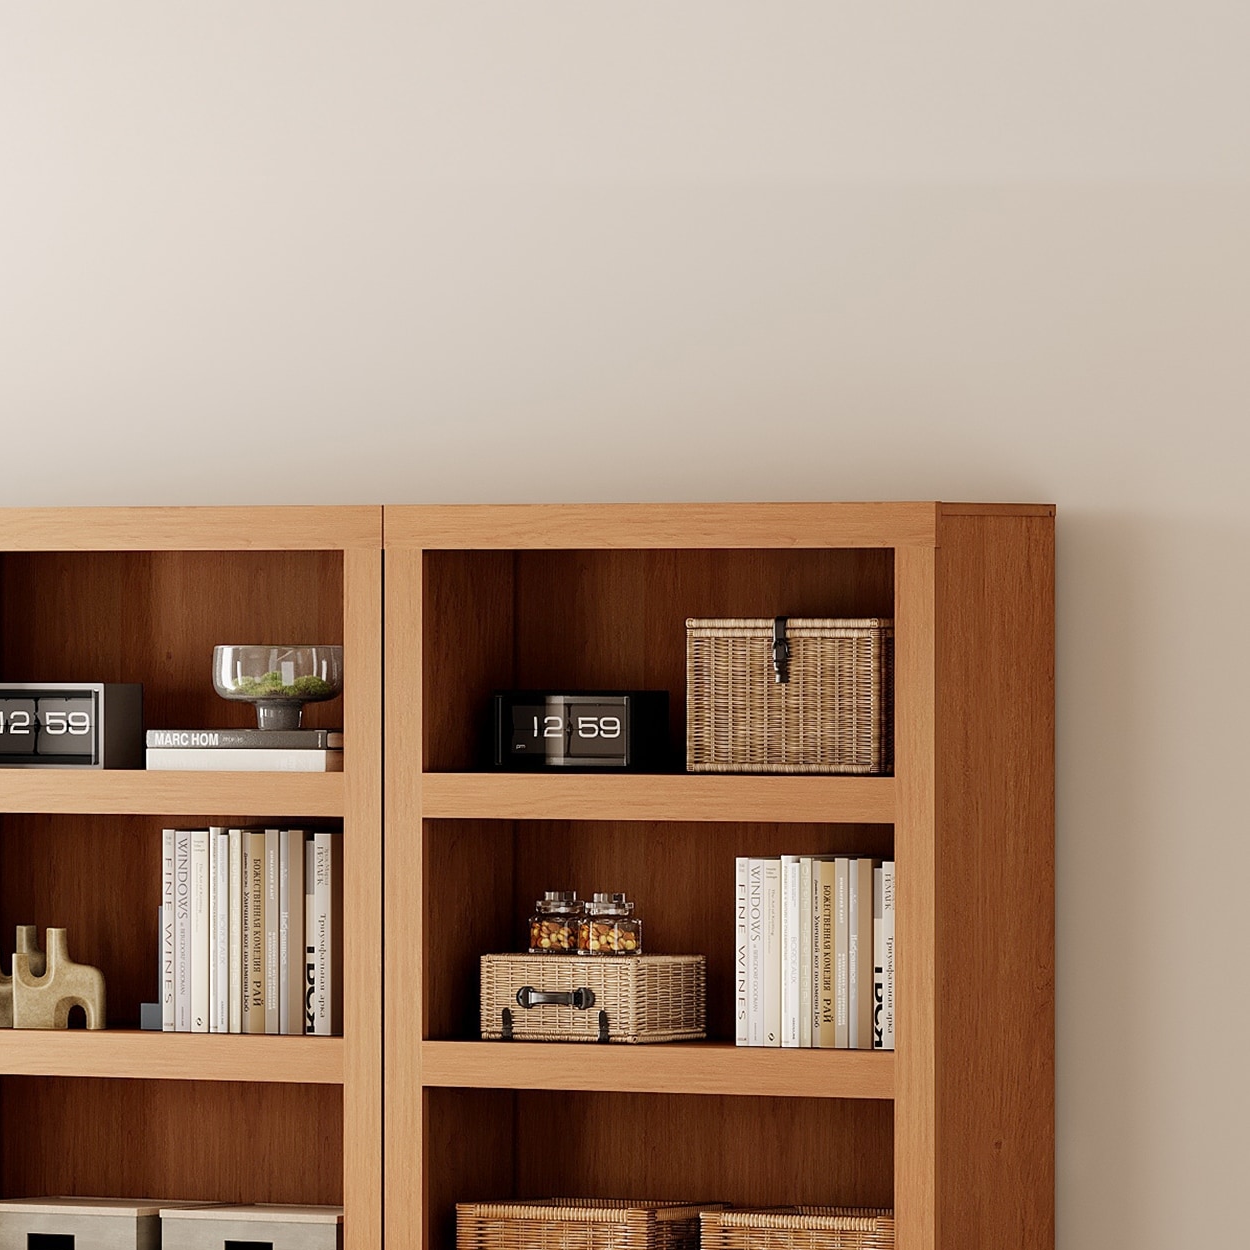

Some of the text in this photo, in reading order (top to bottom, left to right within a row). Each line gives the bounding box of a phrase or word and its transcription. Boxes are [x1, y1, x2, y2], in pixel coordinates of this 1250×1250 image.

[45, 711, 90, 735] 59
[154, 733, 189, 746] MARC
[191, 733, 219, 746] HOM
[578, 716, 620, 739] 59
[177, 838, 188, 919] WINDOWS
[751, 865, 761, 942] WINDOWS
[164, 923, 172, 1004] WINES
[253, 858, 264, 1007] БОЖЕСТВЕННАЯ КОМЕДИЯ РАЙ
[738, 884, 746, 1020] FINE WINES
[823, 885, 834, 1023] БОЖЕСТВЕННАЯ КОМЕДИЯ РАЙ
